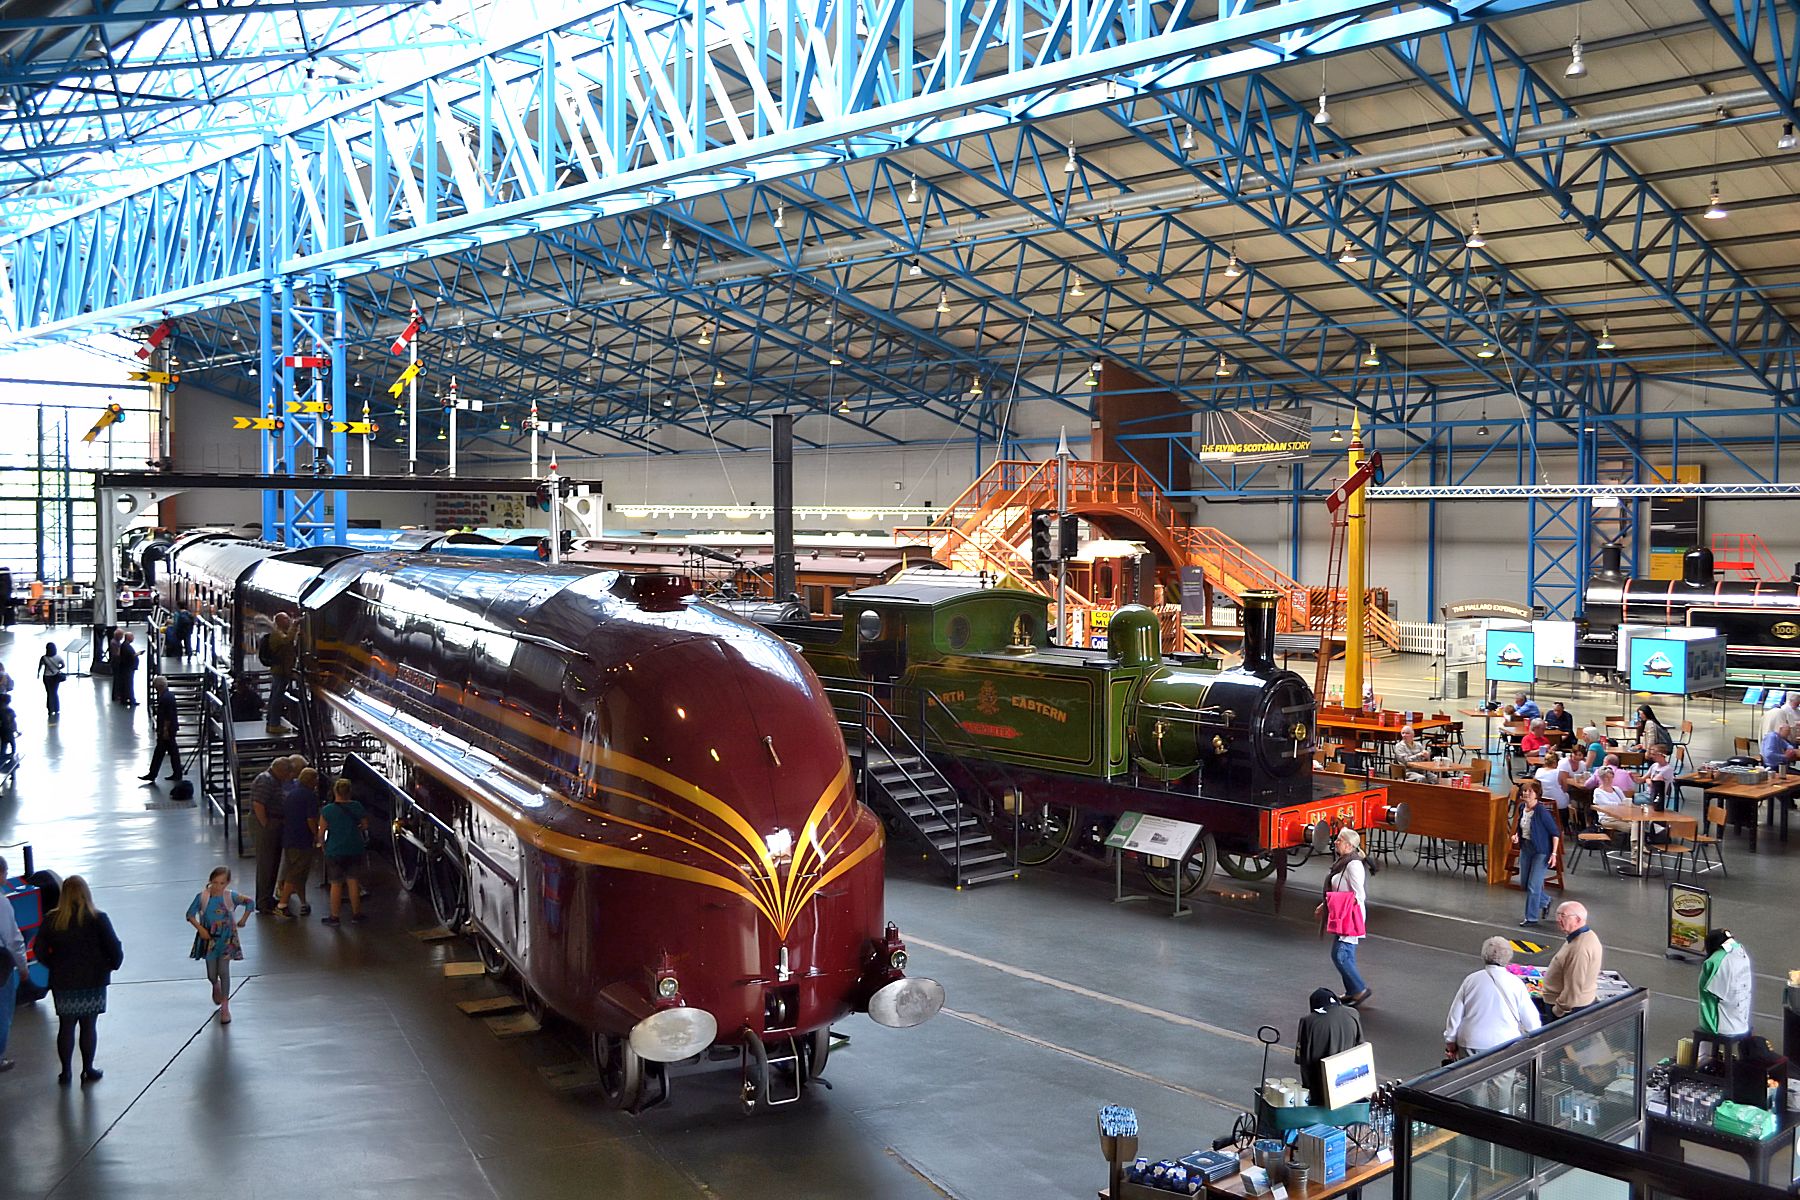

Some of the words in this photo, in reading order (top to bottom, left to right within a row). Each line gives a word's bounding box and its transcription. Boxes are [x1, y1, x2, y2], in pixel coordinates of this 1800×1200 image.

[1201, 444, 1214, 453] THE
[1215, 443, 1242, 453] FLYING
[1243, 441, 1287, 453] SCOTSMAN
[1287, 441, 1311, 451] STORY
[1452, 605, 1464, 613] THE
[1465, 603, 1492, 611] MALLARD
[1492, 604, 1529, 618] EXPERIENCE
[928, 690, 965, 707] NRTH
[1011, 695, 1068, 723] EASTERN
